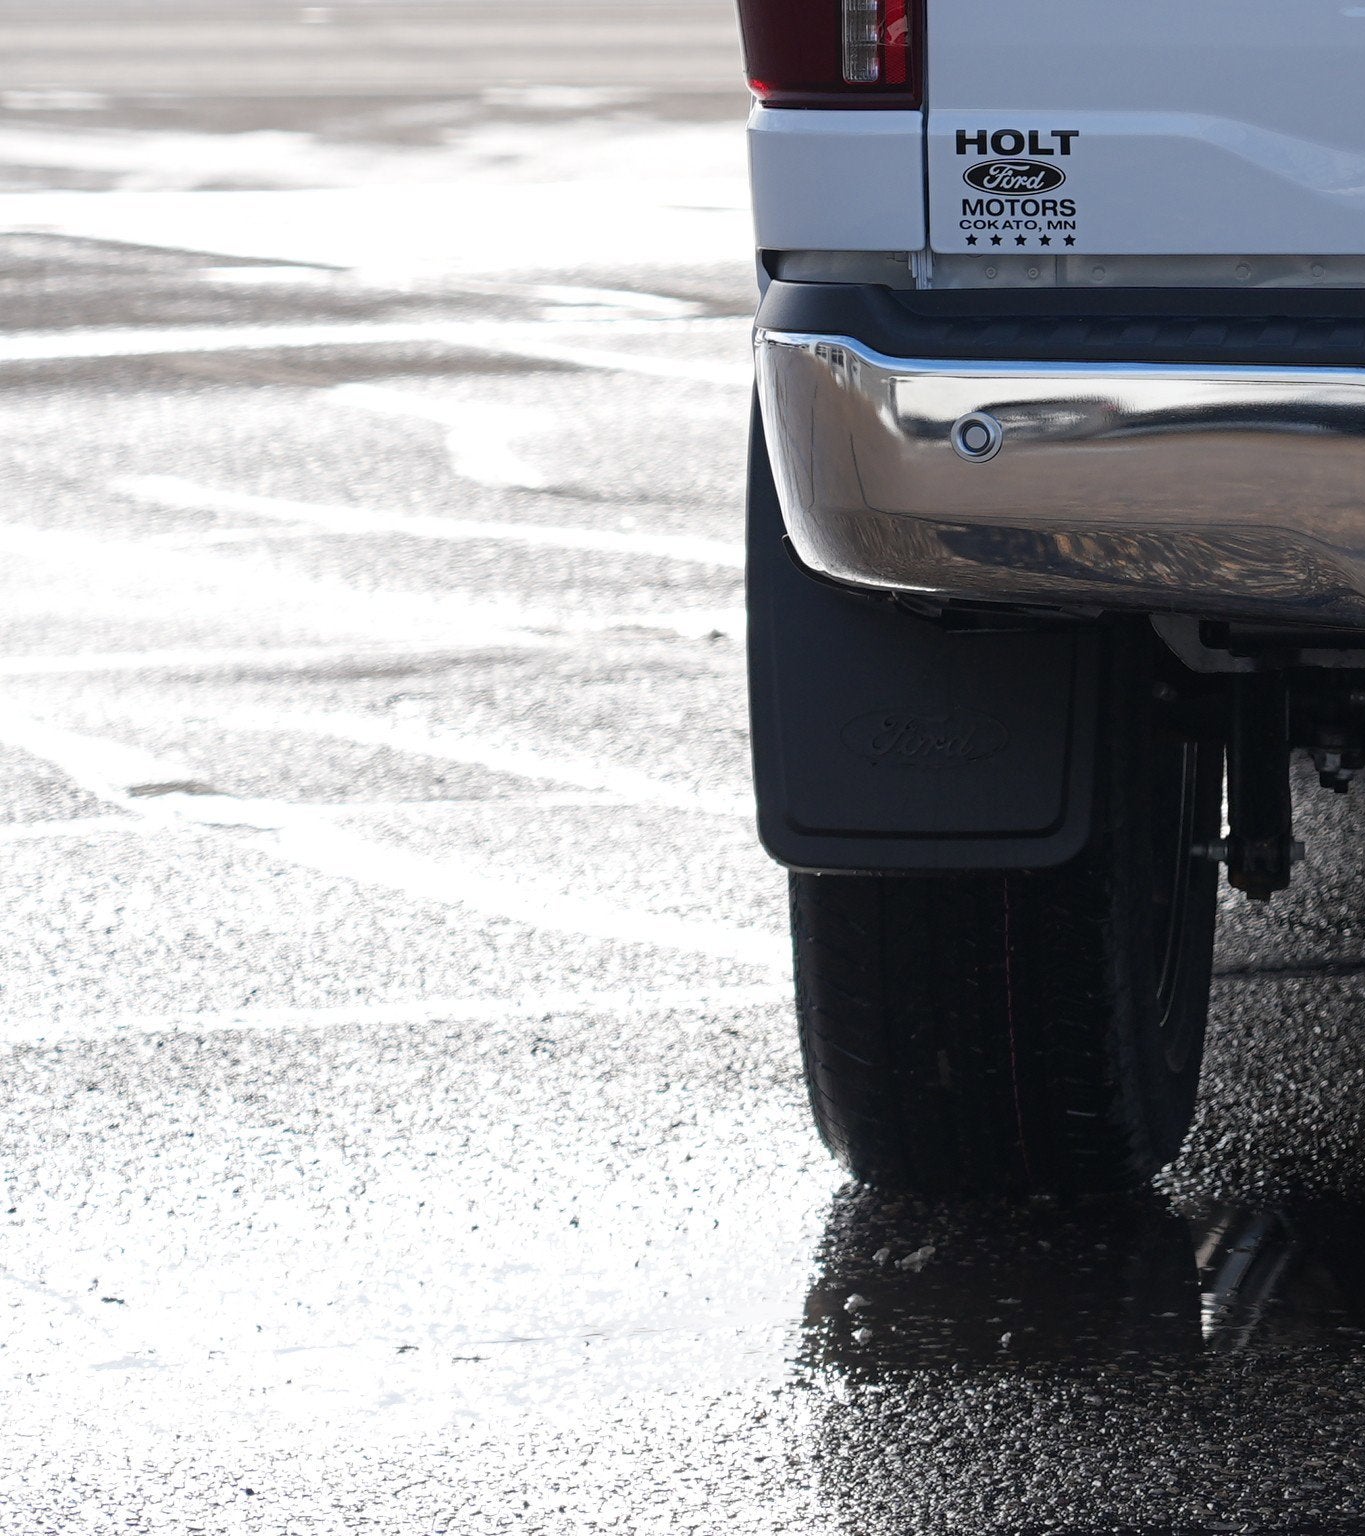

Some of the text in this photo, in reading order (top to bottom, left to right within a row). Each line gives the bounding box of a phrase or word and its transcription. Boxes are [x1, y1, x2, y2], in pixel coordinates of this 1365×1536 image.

[955, 129, 1079, 155] HOLT
[983, 164, 1046, 189] Ford
[962, 199, 1077, 217] MOTORS
[959, 220, 1076, 232] COKATO, MN
